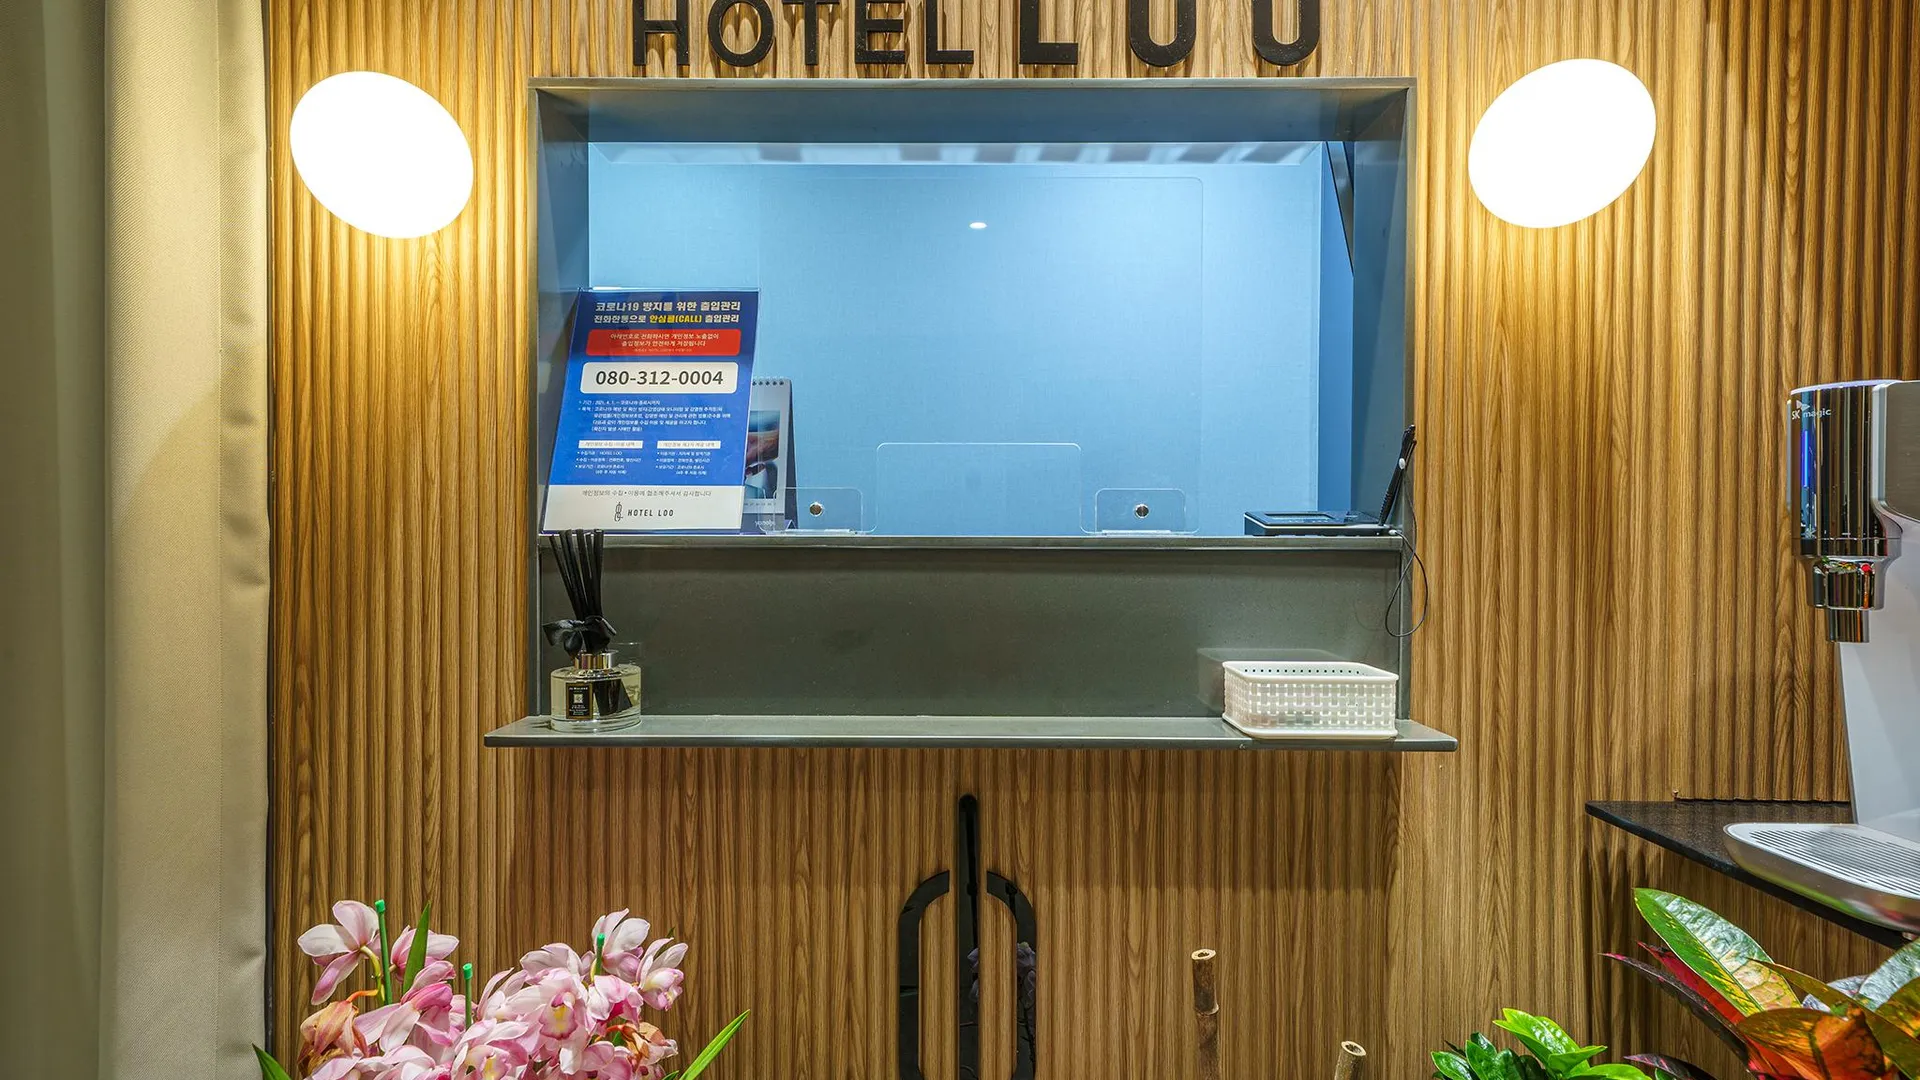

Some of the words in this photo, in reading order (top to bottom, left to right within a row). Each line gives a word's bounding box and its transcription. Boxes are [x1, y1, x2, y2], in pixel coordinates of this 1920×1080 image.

[633, 0, 975, 67] HOTEL
[595, 301, 639, 312] 코로나19
[642, 301, 673, 312] 방지를
[676, 301, 697, 312] 위한
[700, 301, 740, 312] 출입관리
[705, 314, 739, 324] 출입관리
[595, 370, 724, 386] 080-312-0004
[1803, 408, 1832, 419] magic
[627, 509, 653, 517] HOTEL
[658, 509, 674, 517] LOO
